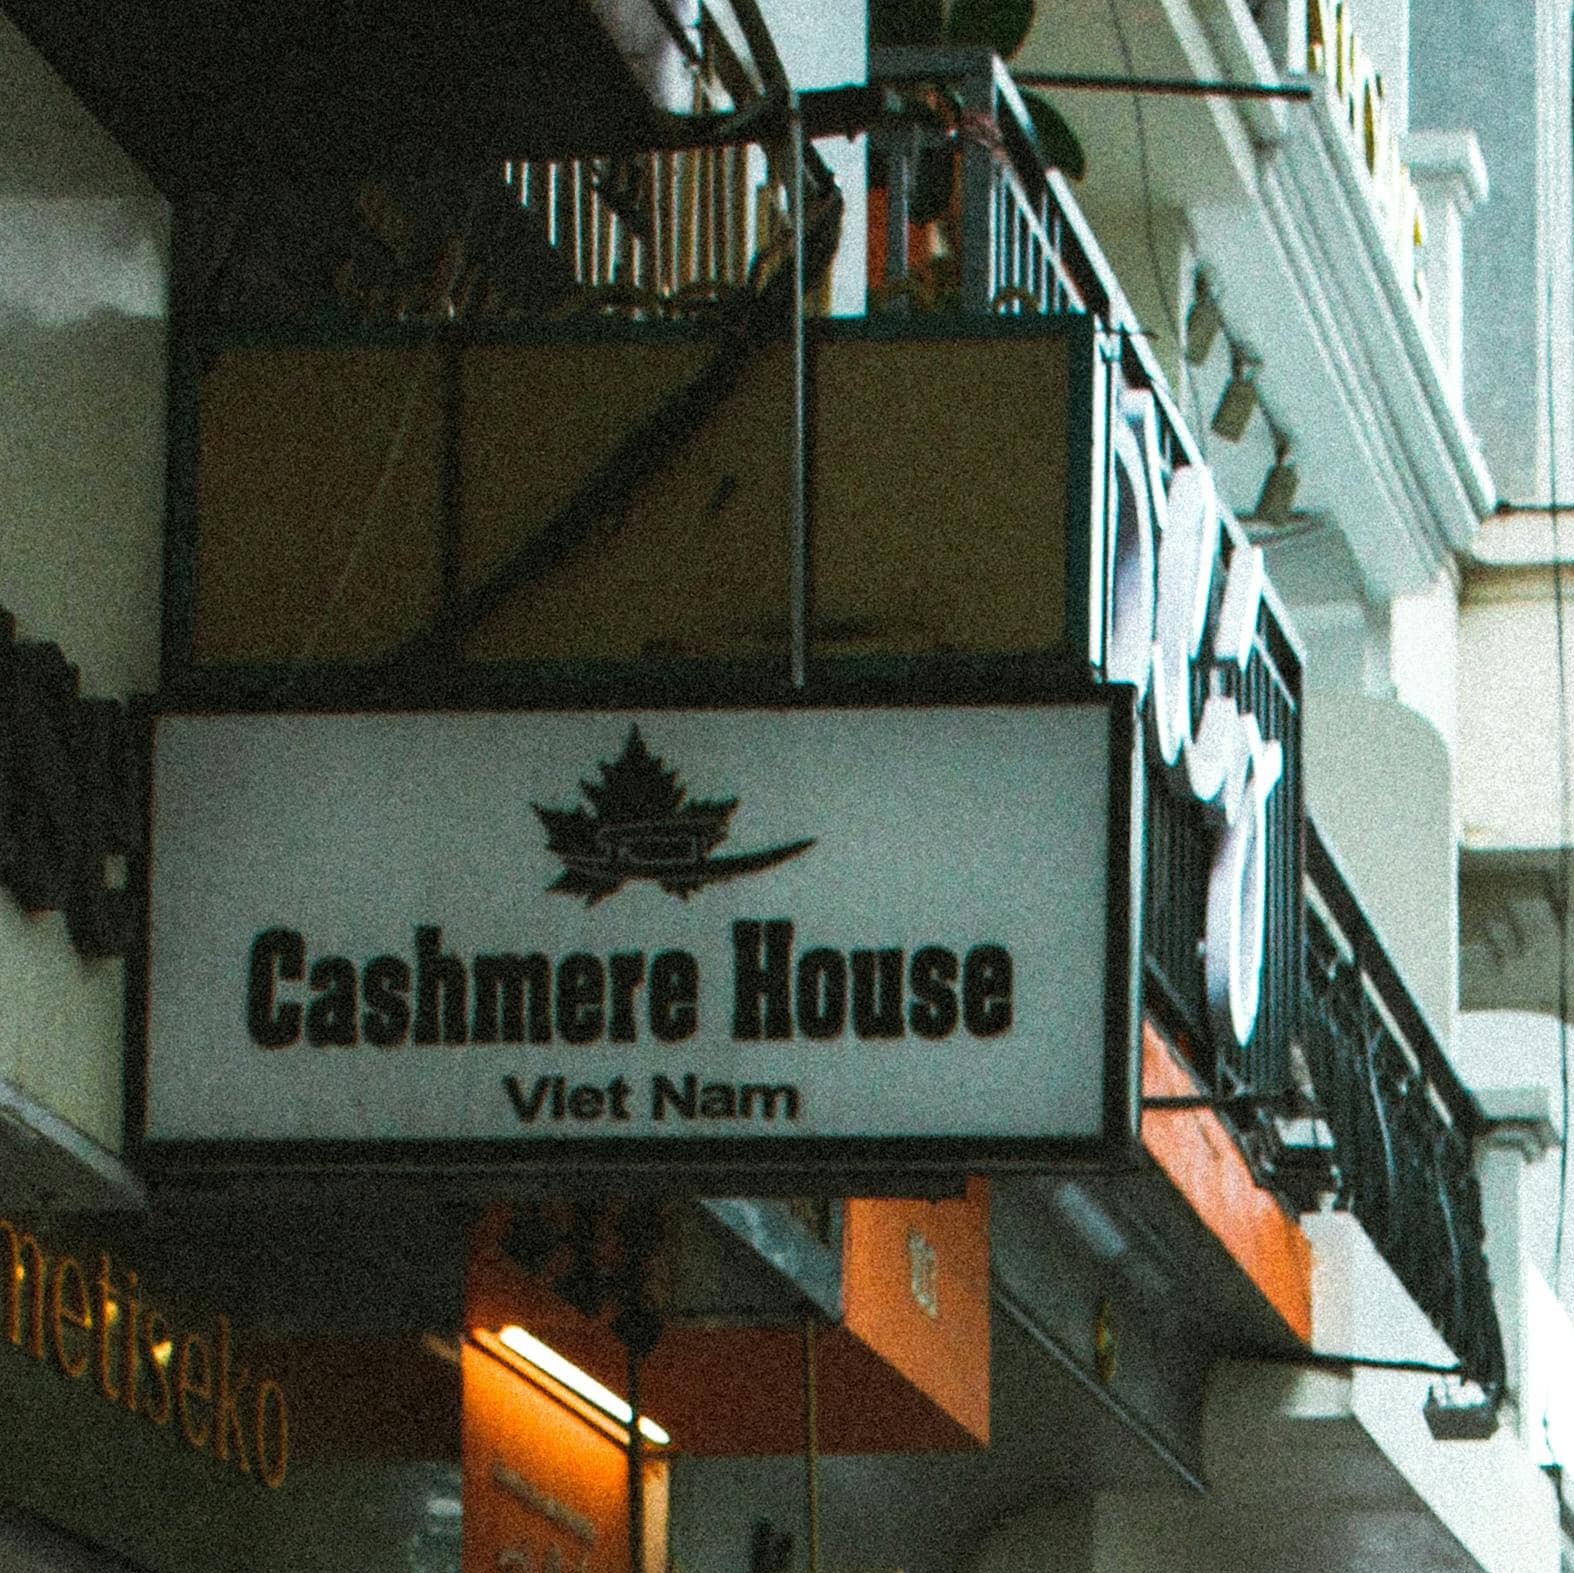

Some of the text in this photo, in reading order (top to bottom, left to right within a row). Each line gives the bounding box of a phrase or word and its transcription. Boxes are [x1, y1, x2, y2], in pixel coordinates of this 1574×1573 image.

[247, 918, 1014, 1048] Cashmere House
[502, 1072, 800, 1126] Viet Nam
